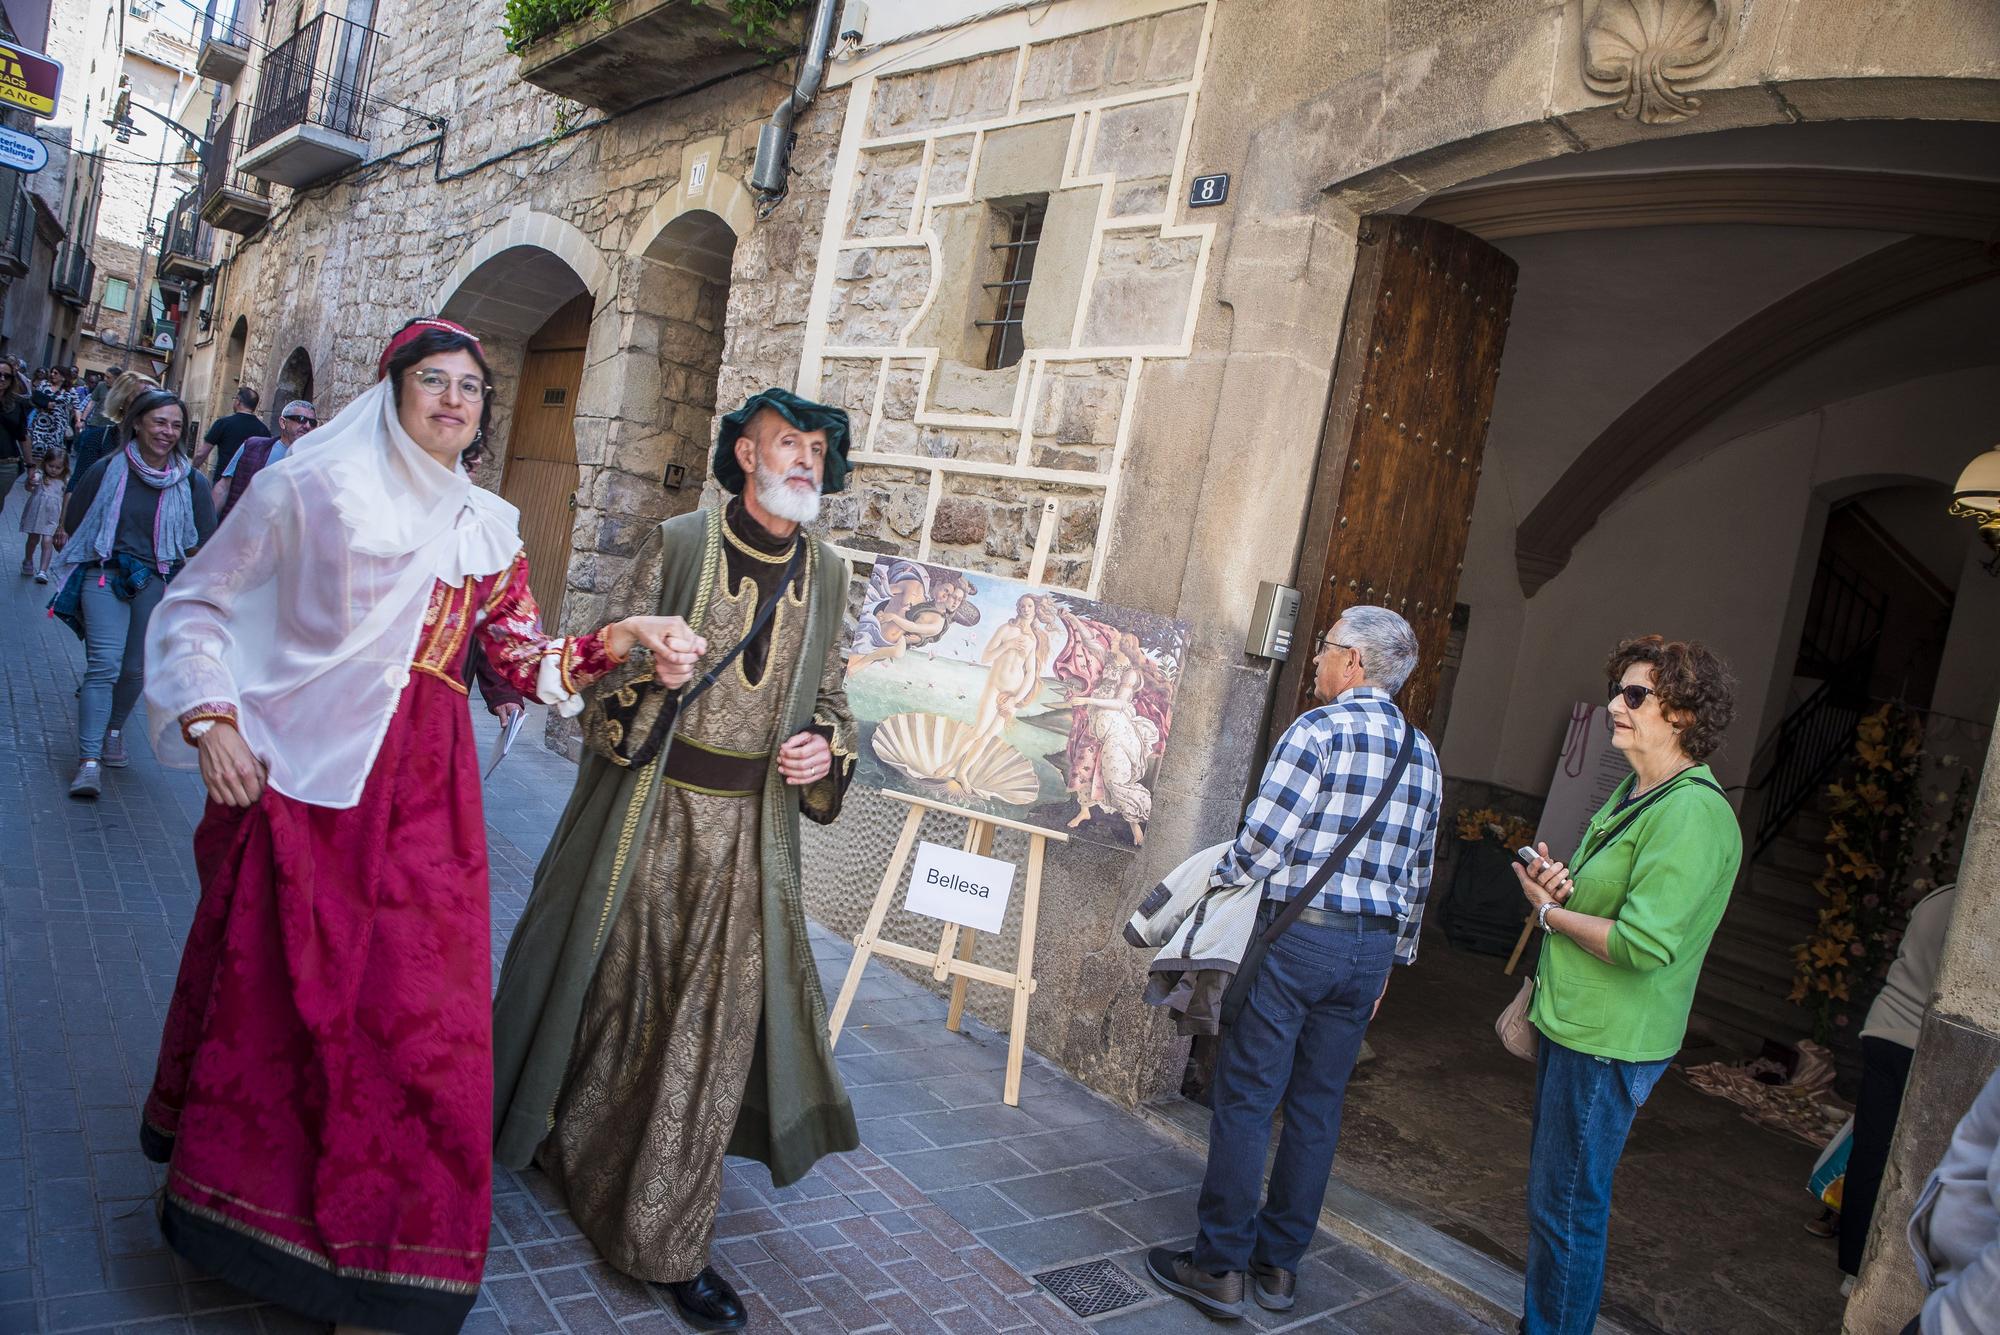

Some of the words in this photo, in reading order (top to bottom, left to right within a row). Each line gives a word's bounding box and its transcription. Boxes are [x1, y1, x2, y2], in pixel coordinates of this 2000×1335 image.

[690, 163, 705, 186] 10
[1201, 179, 1215, 200] 8
[926, 867, 990, 899] Bellesa
